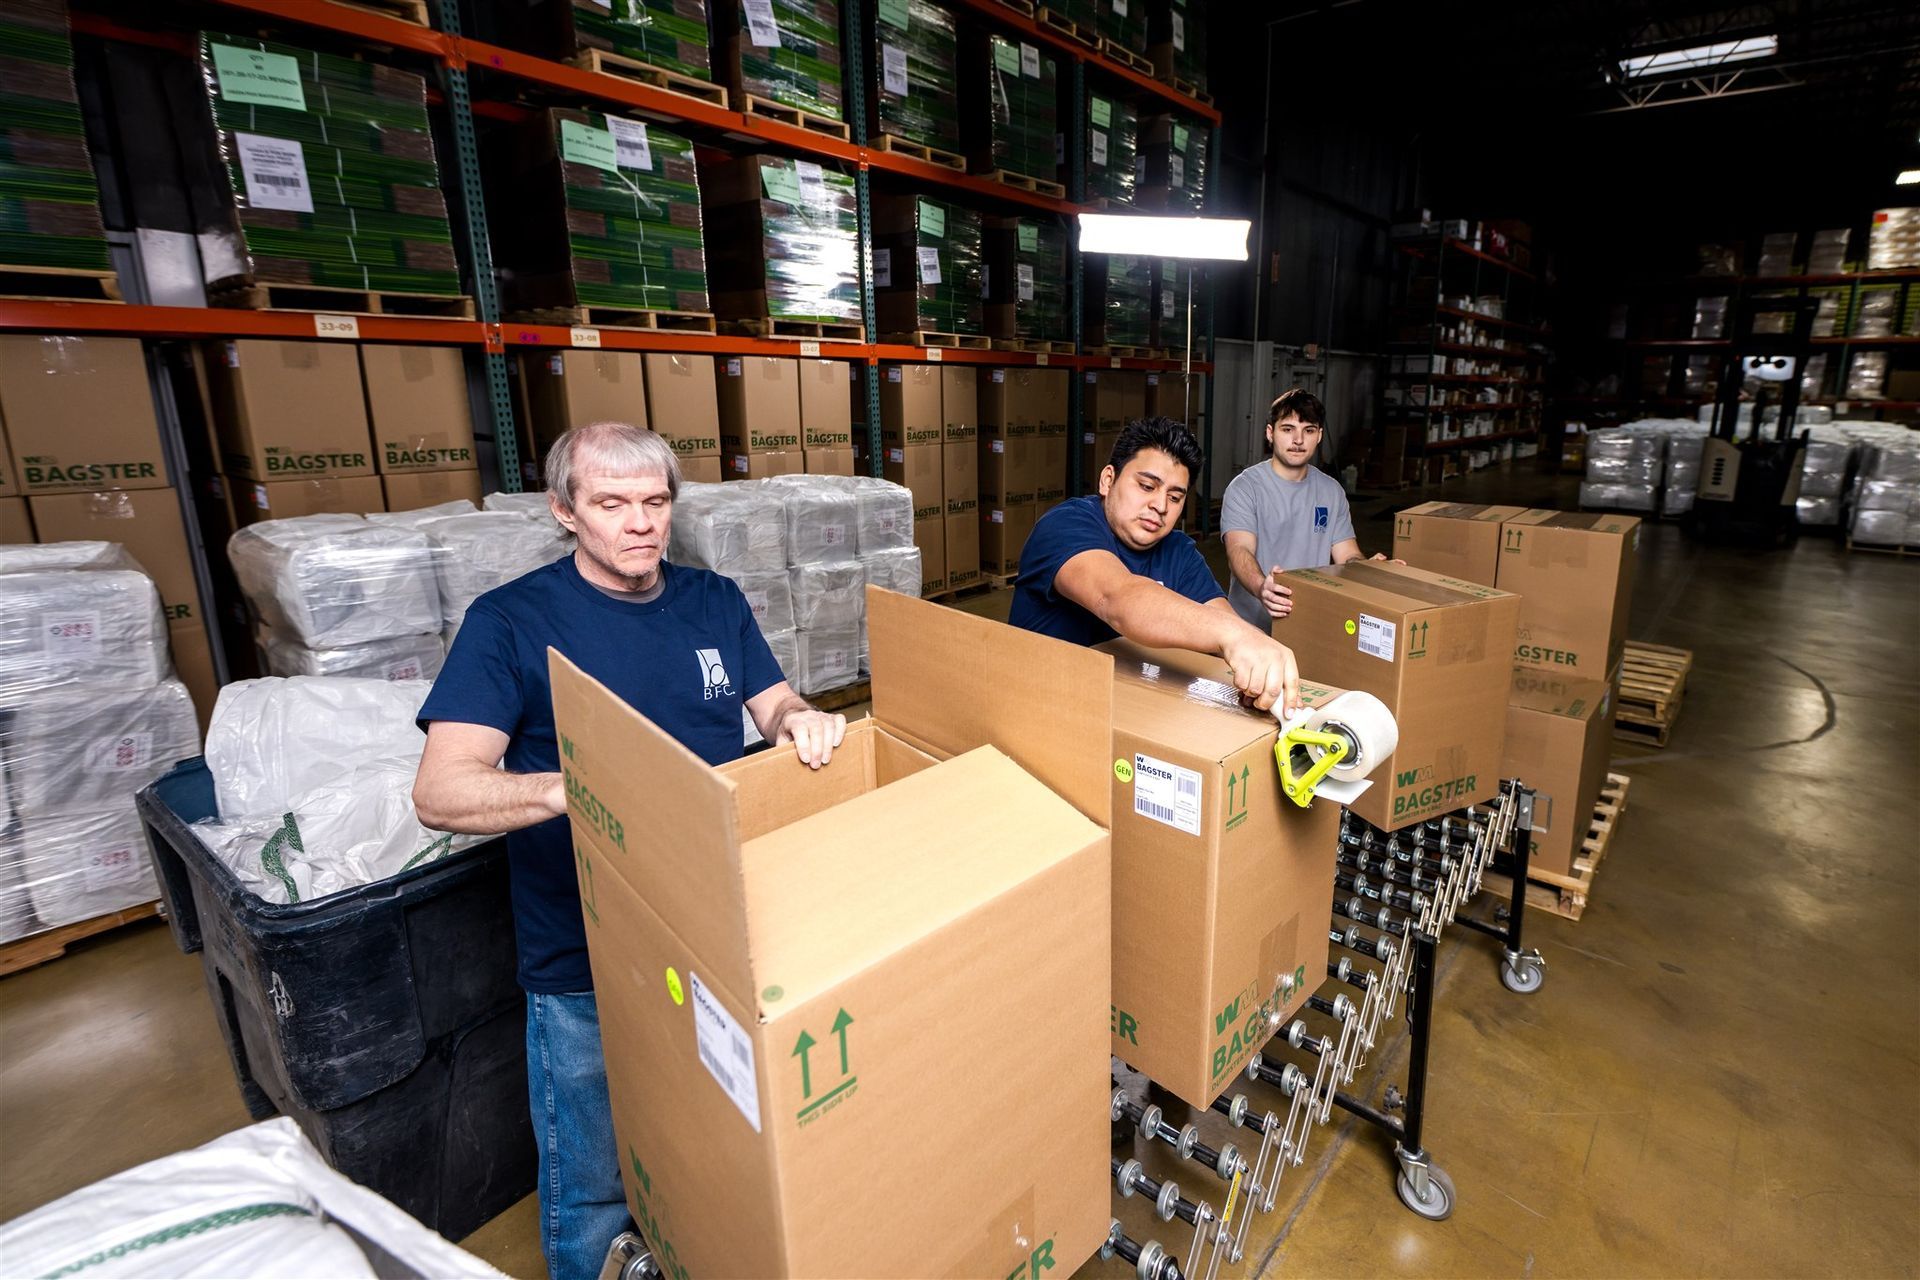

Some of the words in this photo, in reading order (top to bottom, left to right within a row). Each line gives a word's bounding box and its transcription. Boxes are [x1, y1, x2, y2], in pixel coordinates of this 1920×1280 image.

[320, 322, 353, 332] 33-09
[906, 430, 940, 441] BAGSTER
[946, 426, 976, 437] BAGSTER
[1007, 425, 1036, 434] BAGSTER
[669, 438, 716, 451] AGSTER
[751, 435, 798, 447] BAGSTER
[806, 433, 849, 444] BAGSTER
[265, 453, 366, 472] BAGSTER
[386, 448, 471, 465] BAGSTER
[24, 462, 157, 484] BAGSTER
[913, 506, 941, 517] AGSTER
[947, 500, 977, 512] BAGSTER
[949, 570, 978, 584] BAGSTER
[1514, 645, 1578, 666] GSTER
[1116, 764, 1131, 777] GEN
[1136, 763, 1173, 781] BAGSTER
[1394, 774, 1477, 816] BAGSTER
[565, 766, 627, 855] BAGSTER
